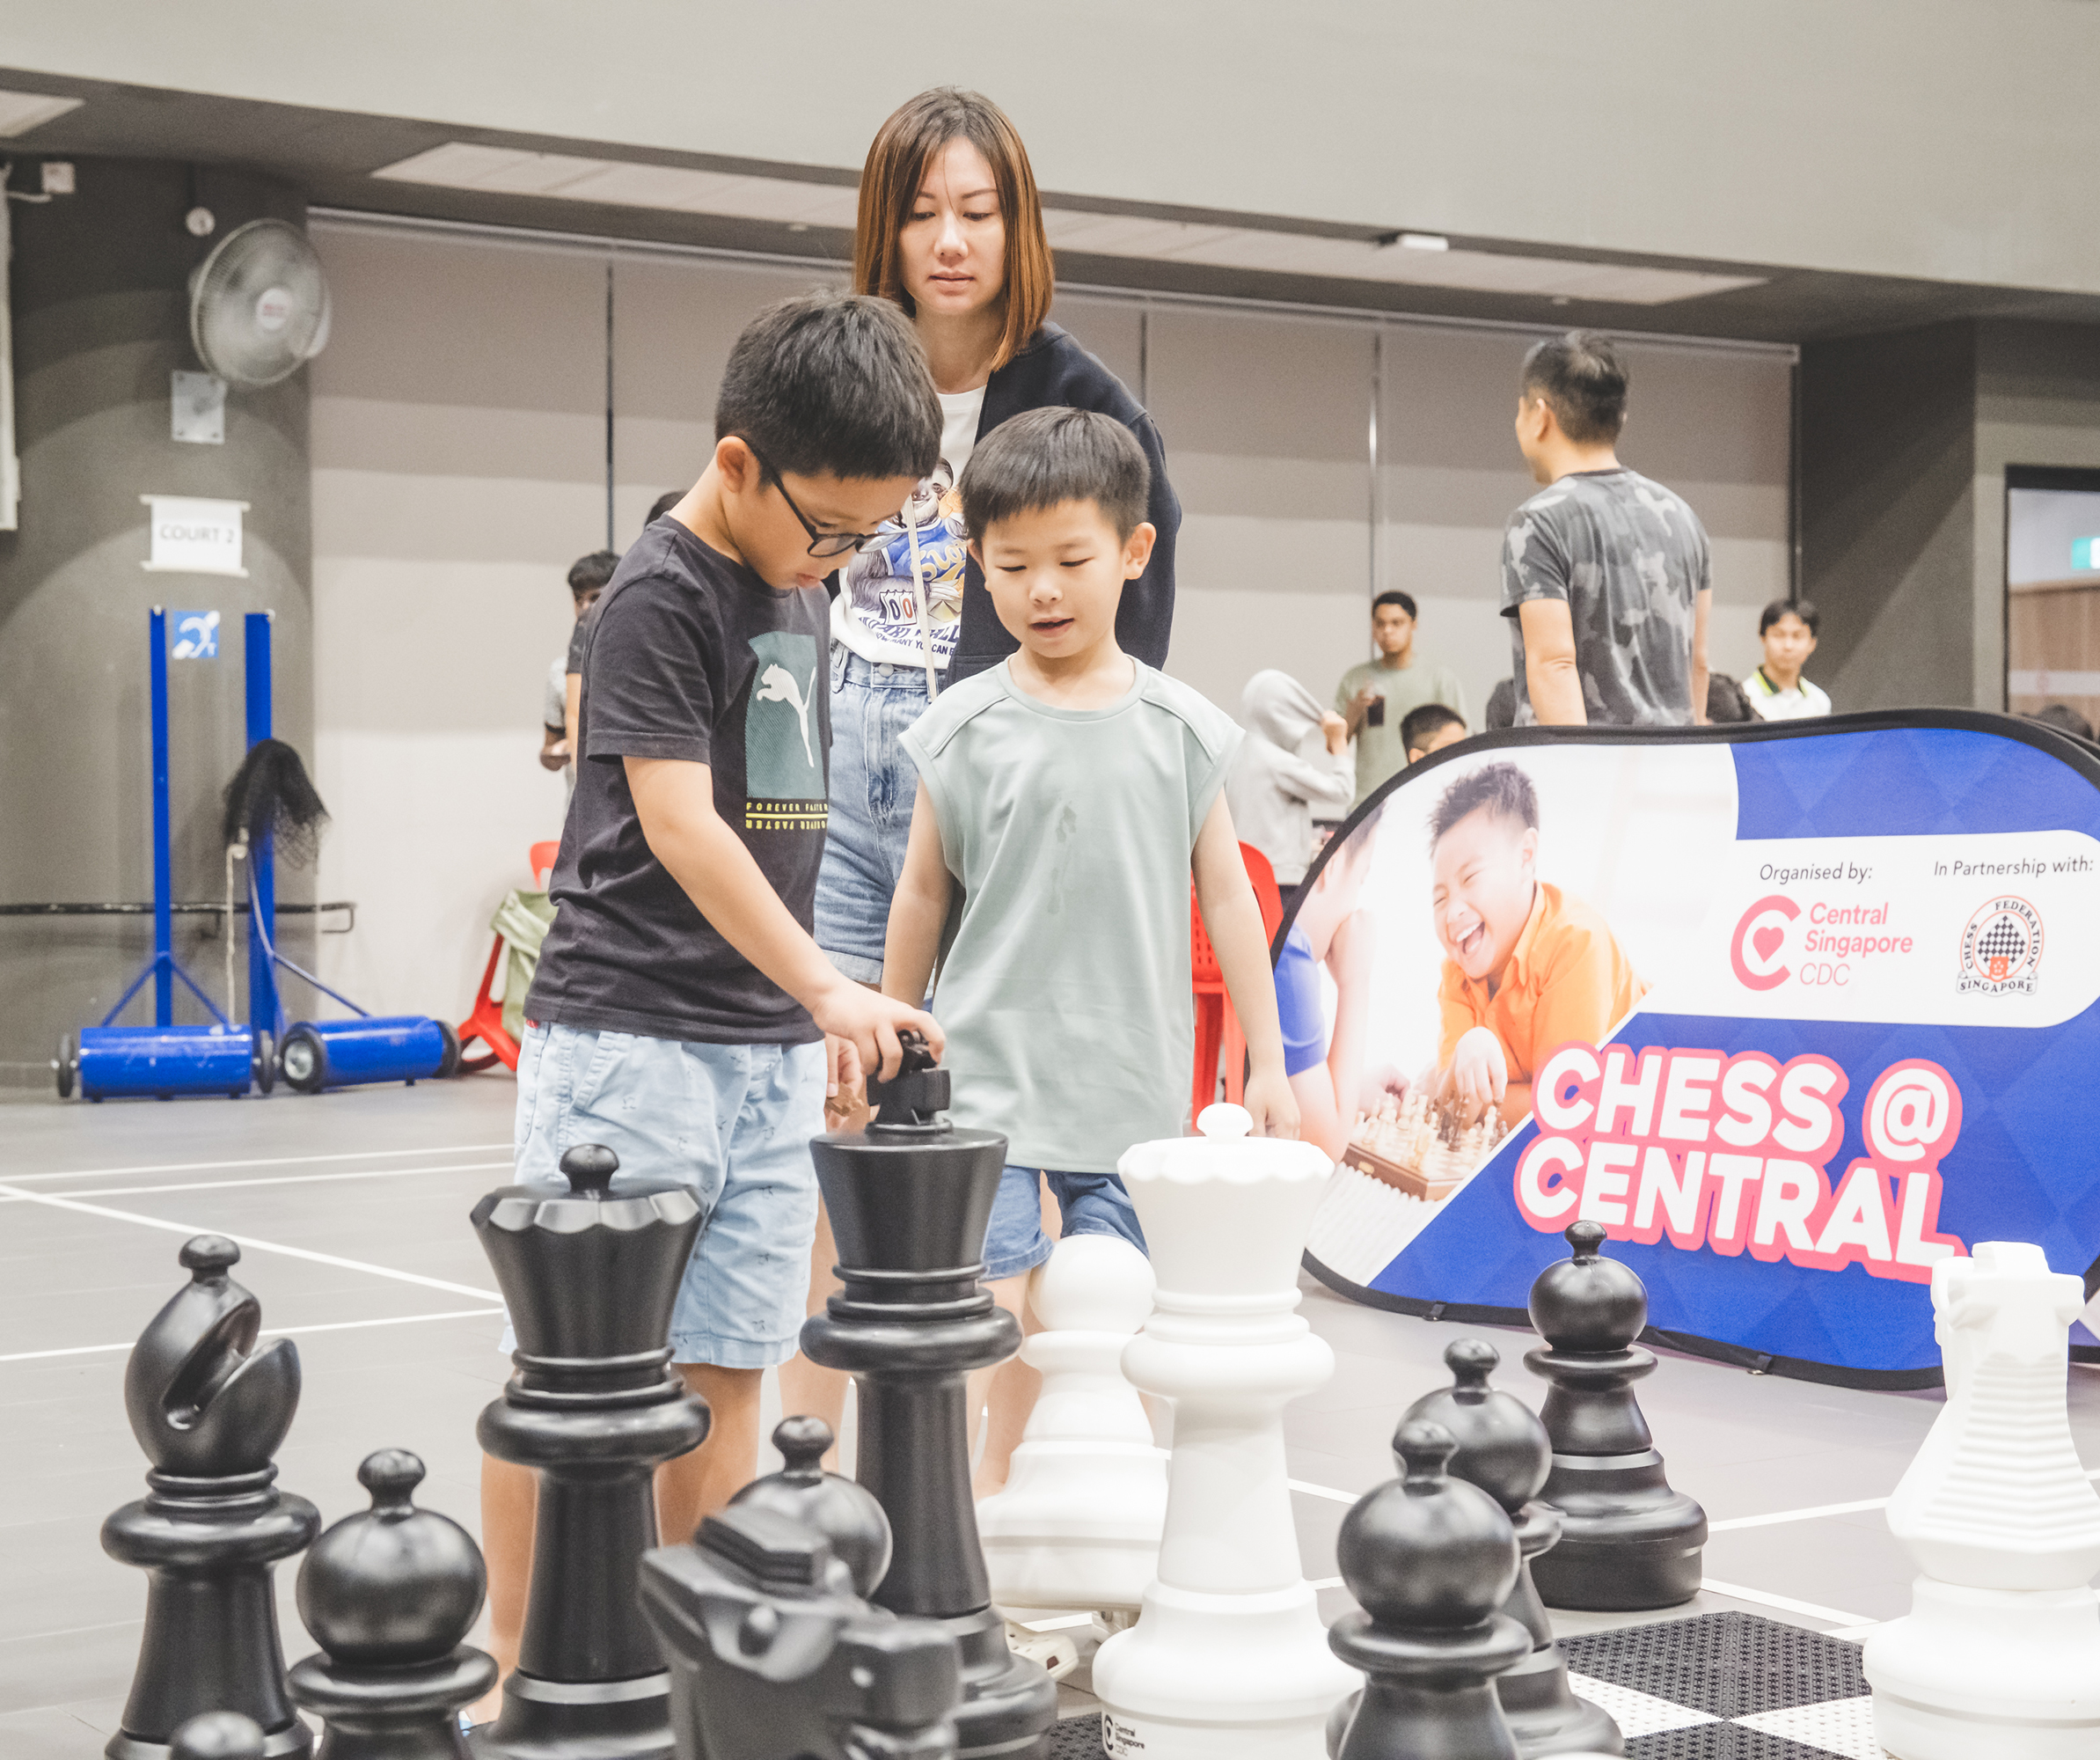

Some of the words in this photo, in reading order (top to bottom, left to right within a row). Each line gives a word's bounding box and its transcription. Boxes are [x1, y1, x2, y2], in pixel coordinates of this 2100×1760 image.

[159, 524, 219, 542] COURT
[226, 529, 235, 543] 2
[931, 644, 948, 656] CAN
[746, 802, 800, 812] FOREVER
[1760, 863, 1842, 885] Organised
[1848, 862, 1873, 884] by:
[1934, 861, 1948, 876] In
[1953, 858, 2047, 878] Partnership
[2052, 855, 2094, 872] with:
[1810, 902, 1889, 925] Central
[1804, 929, 1913, 958] Singapore
[1964, 922, 1978, 970] CHESS
[1994, 899, 2040, 968] FEDERATION
[1800, 962, 1850, 986] CDC
[1959, 979, 2033, 994] SINGAPORE
[1536, 1046, 1839, 1153] CHESS
[1869, 1067, 1950, 1162] @
[1518, 1136, 1956, 1268] CENTRAL
[1115, 1722, 1136, 1737] Central
